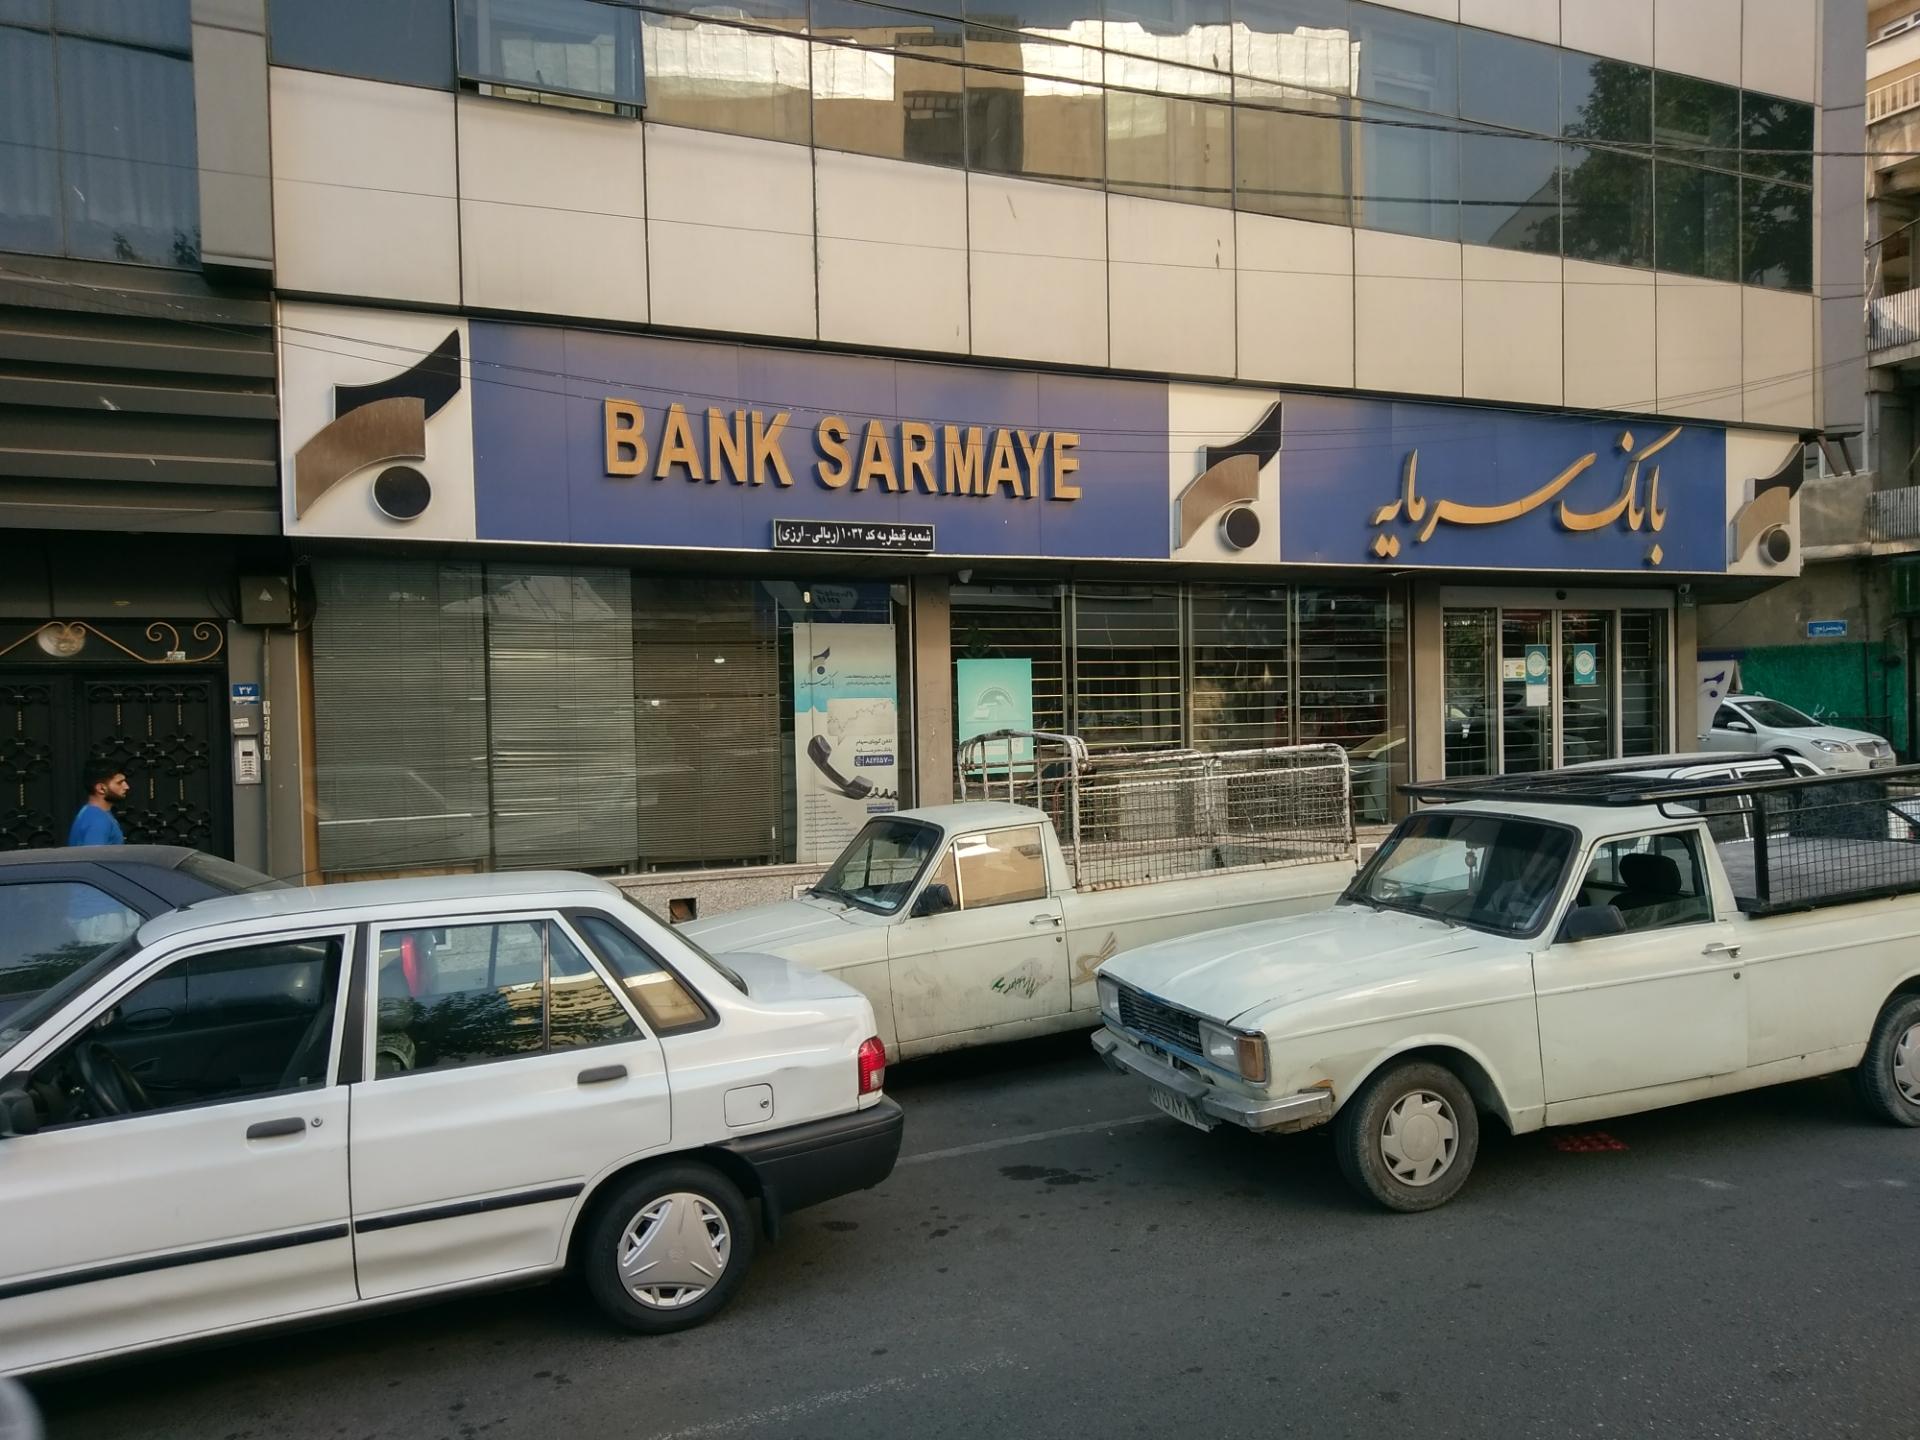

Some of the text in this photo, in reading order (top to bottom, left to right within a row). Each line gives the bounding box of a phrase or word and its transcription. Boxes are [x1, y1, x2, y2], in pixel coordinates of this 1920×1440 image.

[604, 397, 1082, 501] BANK SARMAYE
[1369, 426, 1683, 566] بانک سرمایه
[865, 529, 875, 541] کد
[877, 528, 906, 546] قیطریه
[908, 529, 931, 546] شعبه
